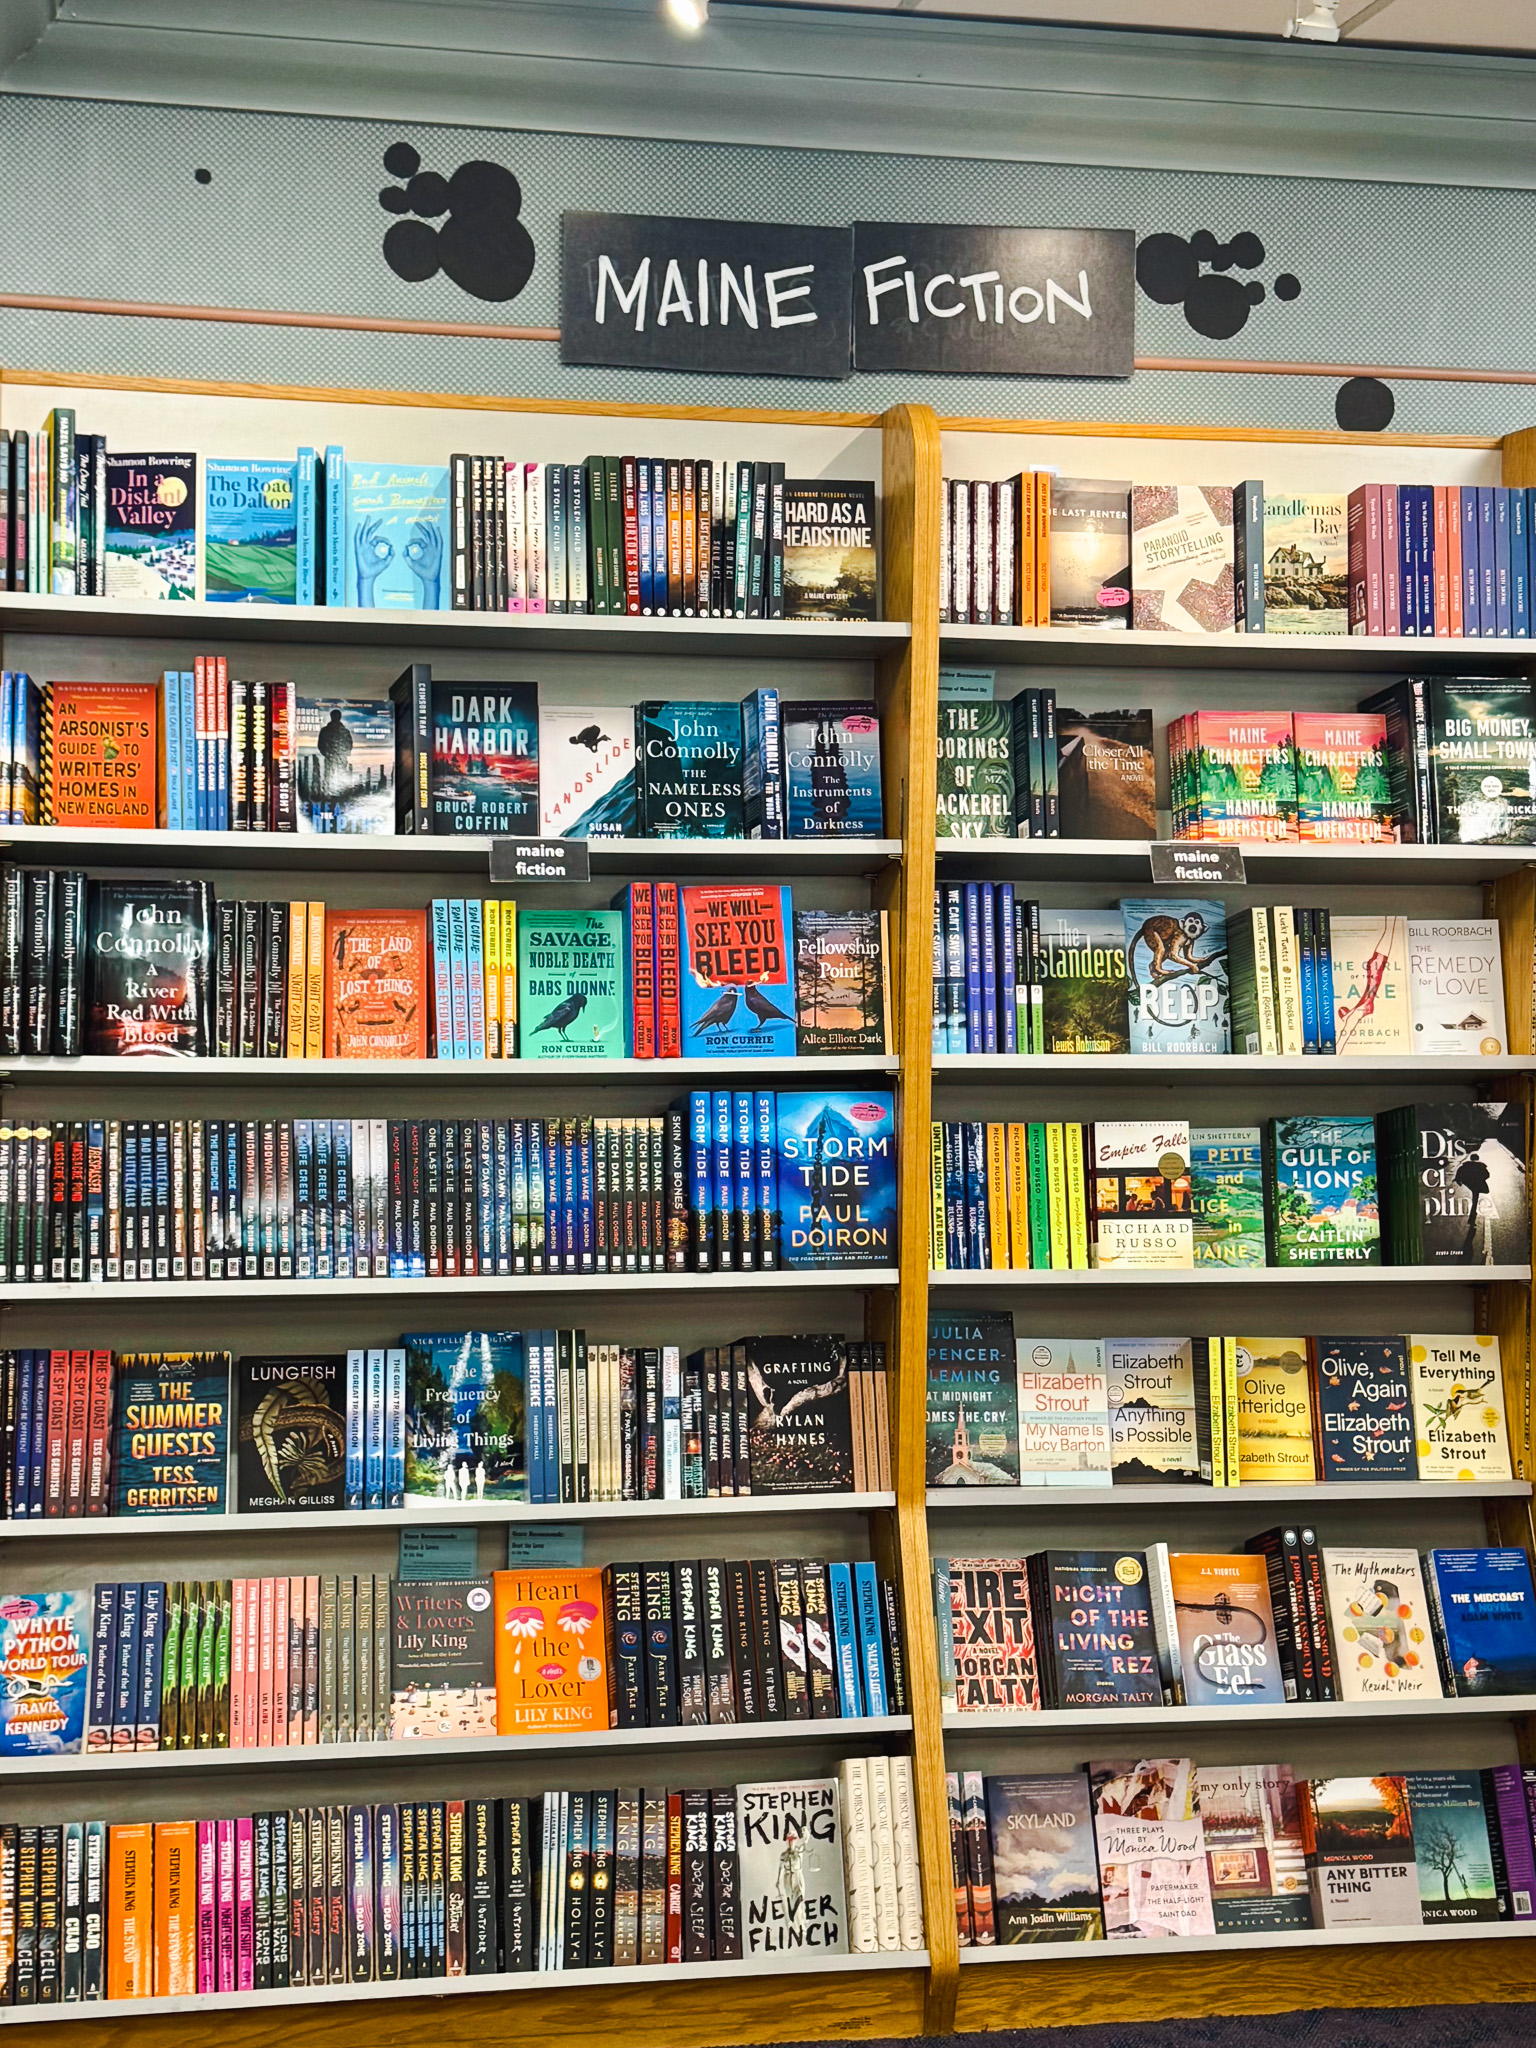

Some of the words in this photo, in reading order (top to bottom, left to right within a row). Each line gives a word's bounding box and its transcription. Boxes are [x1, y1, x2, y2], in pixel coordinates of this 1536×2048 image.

[594, 254, 818, 332] MAINE
[862, 254, 1094, 326] FICTION
[207, 463, 248, 473] Shannon
[251, 464, 291, 475] Bowring
[128, 469, 148, 487] In
[154, 474, 164, 486] a
[208, 475, 241, 492] The
[247, 477, 293, 493] Road
[111, 487, 183, 506] Distant
[209, 493, 227, 507] to
[233, 492, 291, 509] Dalton
[117, 506, 177, 529] Valley
[785, 502, 822, 523] HARD
[831, 503, 852, 523] AS
[855, 503, 866, 524] A
[1061, 508, 1085, 518] LAST
[1089, 509, 1128, 520] RENTER
[1313, 518, 1342, 540] Bay
[1143, 530, 1189, 553] PARANOID
[1146, 532, 1224, 564] STORYTELLING
[58, 703, 76, 715] AN
[452, 696, 513, 724] DARK
[947, 708, 978, 730] THE
[59, 721, 149, 737] ARSONIST'S
[671, 719, 718, 742] John
[58, 743, 96, 755] GUIDE
[123, 744, 139, 755] TO
[435, 728, 528, 755] HARBOR
[646, 741, 740, 765] Connolly
[1209, 749, 1289, 766] CHARACTERS
[59, 761, 141, 777] WRITERS'
[788, 752, 875, 771] Connolly
[682, 769, 707, 779] THE
[649, 783, 741, 796] NAMELESS
[793, 786, 872, 797] Instruments
[57, 802, 87, 814] NEW
[89, 803, 149, 815] ENGLAND
[436, 802, 475, 814] BRUCE
[481, 802, 528, 814] ROBERT
[665, 803, 726, 818] ONES
[826, 802, 839, 814] of
[455, 816, 509, 830] COFFIN
[589, 823, 622, 832] SUSAN
[804, 819, 864, 830] Darkness
[516, 844, 565, 857] maine
[1173, 850, 1220, 863] maine
[515, 861, 565, 875] fiction
[1174, 865, 1222, 881] fiction
[585, 917, 604, 929] The
[530, 932, 616, 948] SAVAGE,
[695, 922, 730, 947] SEE
[734, 919, 776, 945] YOU
[1409, 928, 1429, 937] BILL
[1432, 927, 1493, 937] ROORBACH
[798, 938, 880, 959] Fellowship
[529, 953, 569, 968] NOBLE
[572, 953, 615, 969] DEATH
[696, 947, 779, 976] BLEED
[1411, 956, 1495, 974] REMEDY
[146, 964, 158, 976] A
[820, 962, 860, 979] Point
[1419, 978, 1432, 986] for
[1436, 978, 1489, 995] LOVE
[706, 1036, 728, 1045] RON
[732, 1035, 774, 1044] CURRIE
[803, 1033, 826, 1044] Alice
[828, 1033, 857, 1044] Elliott
[859, 1033, 882, 1043] Dark
[564, 1045, 604, 1053] CURRIE
[1142, 1042, 1161, 1052] BILL
[1167, 1042, 1217, 1053] ROORBACH
[695, 1099, 706, 1145] STORM
[783, 1137, 888, 1158] STORM
[697, 1148, 707, 1178] TIDE
[799, 1166, 869, 1186] TIDE
[1216, 1173, 1243, 1185] and
[1294, 1171, 1363, 1189] LIONS
[799, 1205, 869, 1223] PAUL
[1103, 1224, 1190, 1234] RICHARD
[792, 1228, 887, 1248] DOIRON
[1116, 1238, 1177, 1248] RUSSO
[1289, 1248, 1372, 1260] SHETTERLY
[932, 1327, 982, 1340] JULIA
[1112, 1354, 1184, 1369] Elizabeth
[1430, 1350, 1456, 1362] Tell
[1460, 1351, 1481, 1363] Me
[251, 1366, 336, 1381] LUNGFISH
[764, 1362, 831, 1374] GRAFTING
[1419, 1365, 1496, 1381] Everything
[1023, 1373, 1102, 1390] Elizabeth
[1124, 1374, 1172, 1389] Strout
[942, 1392, 992, 1402] MIDNIGHT
[1351, 1380, 1407, 1402] Again
[1035, 1394, 1089, 1412] Strout
[126, 1403, 222, 1429] SUMMER
[776, 1415, 824, 1427] RYLAN
[1115, 1408, 1186, 1426] Anything
[1324, 1413, 1410, 1432] Elizabeth
[1026, 1424, 1047, 1436] My
[1050, 1424, 1090, 1436] Name
[1093, 1424, 1104, 1436] Is
[1112, 1428, 1124, 1442] Is
[1128, 1428, 1192, 1443] Possible
[1428, 1430, 1496, 1443] Elizabeth
[132, 1431, 216, 1459] GUESTS
[776, 1433, 825, 1445] HYNES
[1024, 1439, 1059, 1452] Lucy
[1061, 1438, 1105, 1451] Barton
[1352, 1435, 1411, 1454] Strout
[1441, 1447, 1487, 1460] Strout
[127, 1486, 218, 1507] GERRITSEN
[249, 1496, 295, 1506] MEGHAN
[299, 1495, 335, 1505] GILLISS
[516, 1581, 580, 1601] Heart
[1054, 1585, 1123, 1603] NIGHT
[1451, 1593, 1471, 1604] THE
[1474, 1592, 1524, 1602] MIDCOAST
[396, 1595, 463, 1612] Writers
[533, 1637, 569, 1656] the
[1059, 1633, 1135, 1651] LIVING
[1112, 1656, 1154, 1674] REZ
[520, 1679, 586, 1699] Lover
[1066, 1693, 1119, 1703] MORGAN
[1121, 1692, 1153, 1702] TALTY
[14, 1700, 60, 1715] TRAVIS
[515, 1708, 548, 1723] LILY
[553, 1706, 593, 1721] KING
[5, 1717, 69, 1735] KENNEDY
[743, 1789, 834, 1811] STEPHEN
[744, 1809, 836, 1848] KING
[1007, 1812, 1076, 1830] SKYLAND
[1142, 1826, 1164, 1834] PLAYS
[1326, 1870, 1356, 1880] ANY
[1360, 1867, 1408, 1879] BITTER
[1328, 1882, 1372, 1894] THING
[670, 1884, 681, 1915] CARRIE
[749, 1894, 839, 1924] NEVER
[570, 1897, 582, 1948] HOLLY
[1008, 1915, 1028, 1925] Ann
[1031, 1912, 1054, 1924] Joslin
[1056, 1912, 1092, 1923] Williams
[749, 1922, 839, 1953] FLINCH
